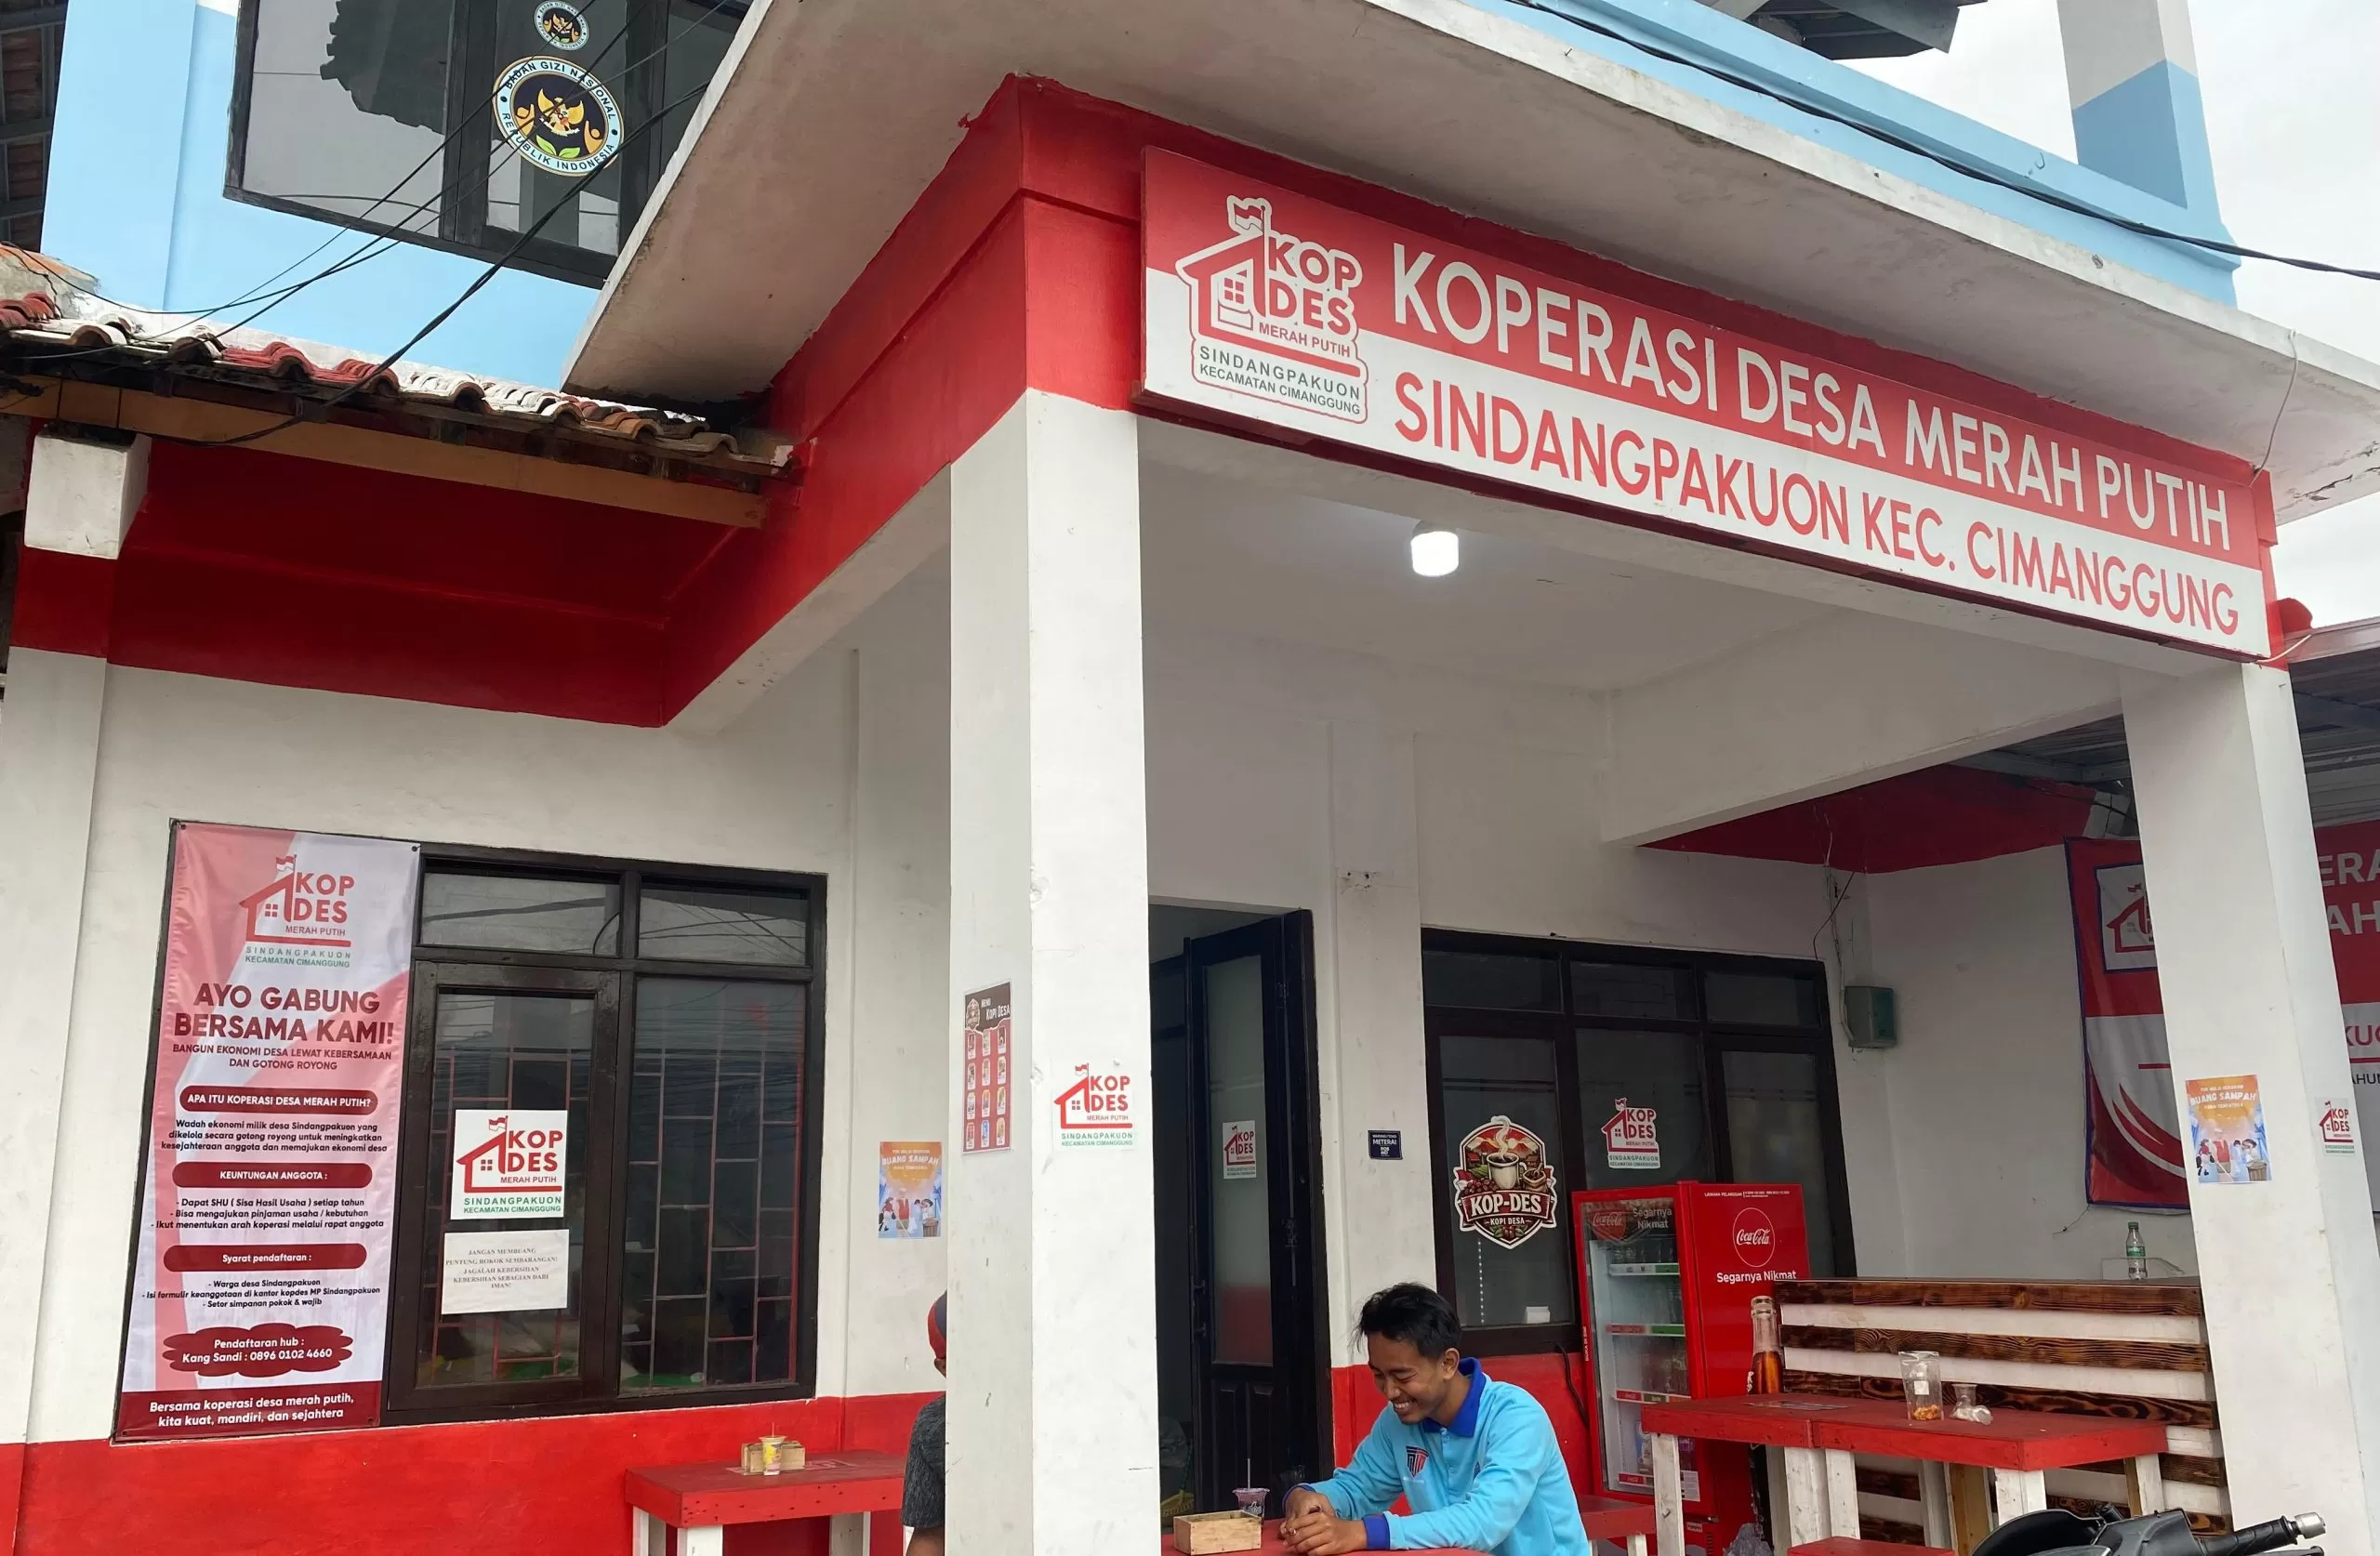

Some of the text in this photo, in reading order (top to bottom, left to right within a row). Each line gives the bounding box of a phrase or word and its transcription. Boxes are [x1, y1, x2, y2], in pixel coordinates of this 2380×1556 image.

[506, 60, 617, 120] BADAN GIZI NASONAL
[557, 144, 615, 171] INDONESIA
[1267, 236, 1356, 291] KOP
[1267, 277, 1351, 336] DES
[1259, 321, 1351, 358] MERAH PUTIH
[1199, 344, 1360, 401] SINDANGPAKUON
[1199, 363, 1360, 415] KECAMATAN CIMANGGUNG
[1394, 242, 2231, 551] KOPERASI DESA MERAH PUTIH
[1395, 371, 2239, 636] SINDANGPAKUON KEC. CIMANGGUNG
[296, 872, 355, 896] KOP
[294, 898, 348, 923] DES
[285, 926, 346, 937] MERAH PUTIH
[245, 946, 351, 959] SINDANGPAKUON
[245, 956, 350, 968] KECAMATAN CIMANGGUNG
[193, 982, 380, 1013] AYO GABUNG
[174, 1013, 393, 1045] BERSAMA KAMI!
[173, 1045, 392, 1061] BANGUN EKONOMI DESA LEWAT KEBERSAMAAN
[229, 1058, 337, 1071] DAN GOTONG ROYONG
[1091, 1075, 1130, 1091] KOP
[187, 1094, 371, 1108] APA ITU KOPERASI DESA MERAH PUTIH?
[1091, 1095, 1129, 1112] DES
[2220, 1092, 2255, 1101] SAMPAH
[1627, 1109, 1655, 1122] KOP
[2333, 1108, 2348, 1119] KOP
[176, 1119, 377, 1132] Wadah ekonomi milik desa Sindangpakuon yang
[1628, 1125, 1653, 1139] DES
[2334, 1121, 2349, 1131] DES
[168, 1130, 203, 1140] dikelola
[236, 1132, 265, 1142] gotong
[268, 1133, 297, 1142] royong
[298, 1133, 322, 1141] untuk
[324, 1134, 382, 1143] meningkatkan
[508, 1130, 563, 1149] KOP
[1238, 1131, 1254, 1141] KOP
[161, 1142, 388, 1153] kesejahteraan anggota dan memajukan ekonomi desa
[1238, 1143, 1253, 1154] DES
[508, 1152, 558, 1172] DES
[909, 1155, 939, 1165] SAMPAH
[219, 1170, 323, 1180] KEUNTUNGAN ANGGOTA
[181, 1198, 364, 1208] Dapat SHU Sisa Hasil Usaha setiap tahun
[1470, 1193, 1541, 1217] KOP-DES
[176, 1209, 368, 1220] Bisa mengajukan pinjaman usaha kebutuhan
[1633, 1208, 1673, 1218] Segarnya
[156, 1220, 384, 1231] Ikut menentukan arah koperasi melalui rapat anggota
[1637, 1220, 1668, 1229] Nikmat
[222, 1253, 307, 1263] Syarat pendaftaran
[213, 1279, 321, 1288] Warga desa Sindangpakuon
[1716, 1270, 1796, 1284] Segarnya Nikmat
[214, 1337, 298, 1349] Pendaftaran hub
[182, 1349, 333, 1365] Kang Sandi 0896 0102 4660
[150, 1393, 354, 1413] Bersama koperasi desa merah putih,
[158, 1408, 344, 1428] kita kuat, mandiri, dan sejahtera
